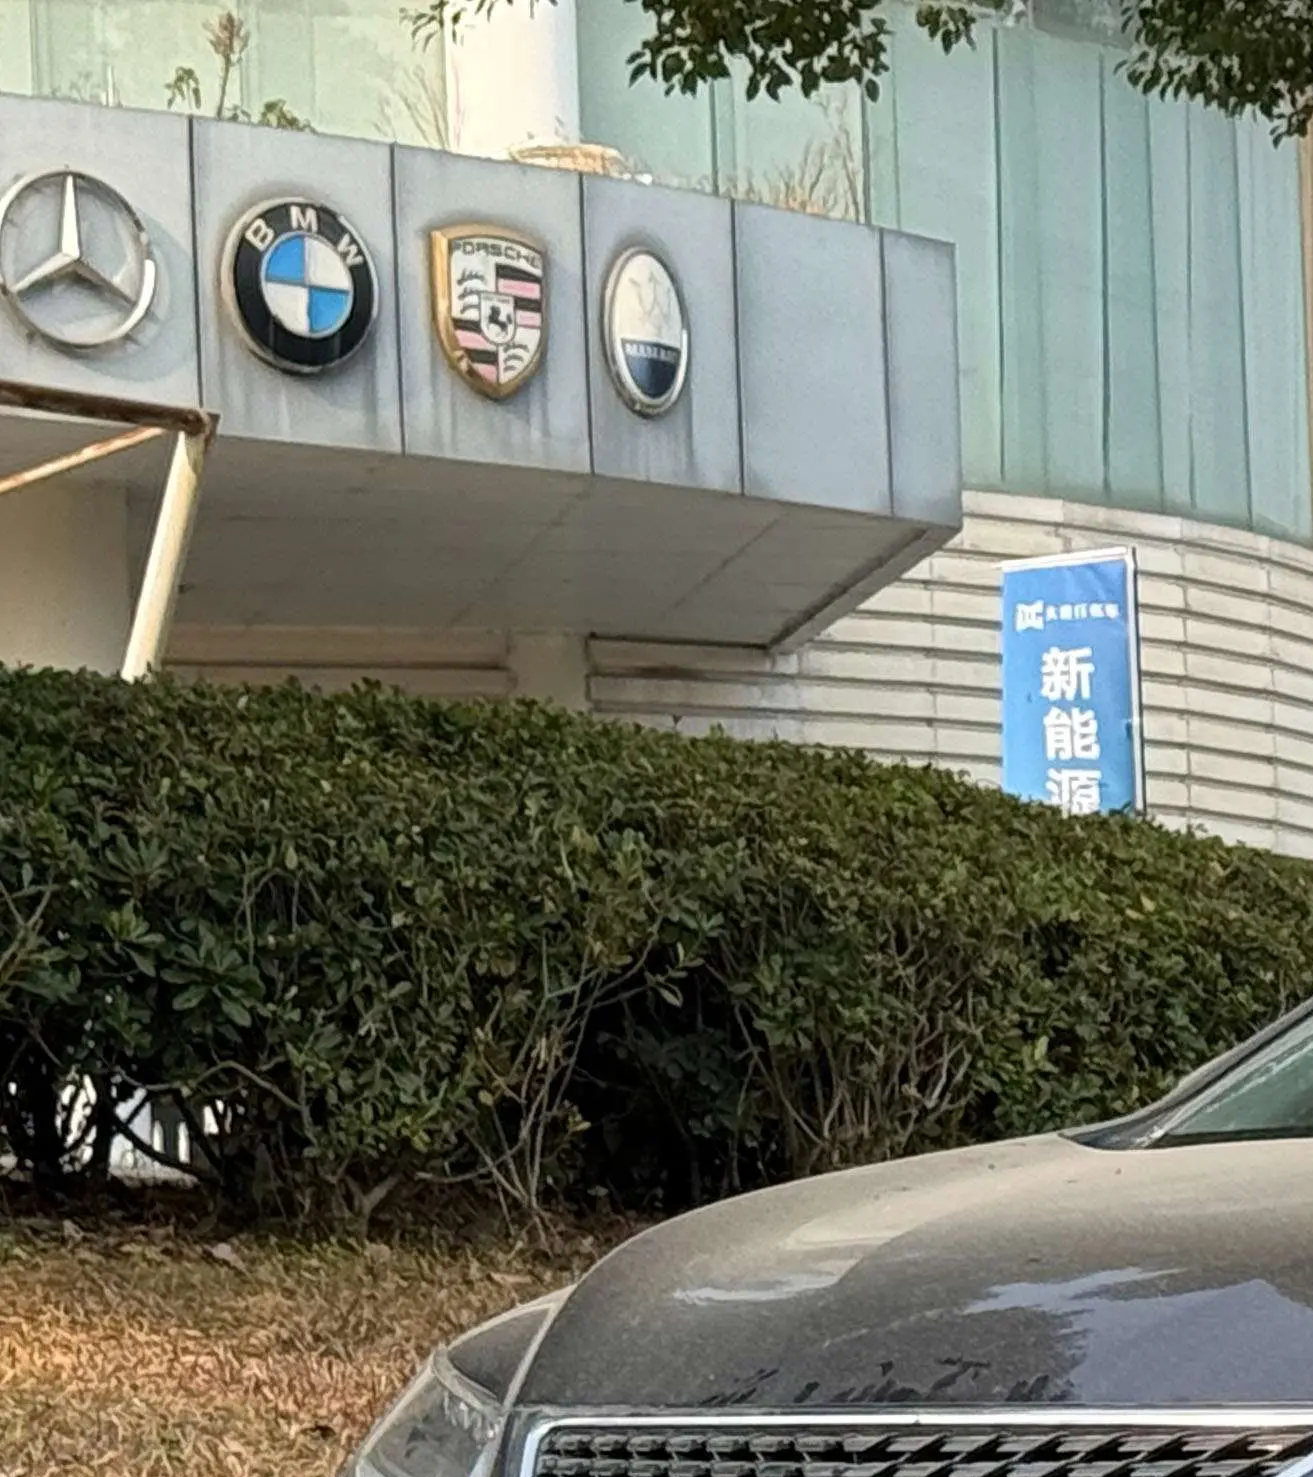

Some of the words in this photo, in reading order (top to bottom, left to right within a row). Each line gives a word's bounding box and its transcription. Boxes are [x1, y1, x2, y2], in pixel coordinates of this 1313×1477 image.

[245, 205, 364, 266] BMW
[1041, 646, 1102, 817] 新能源
